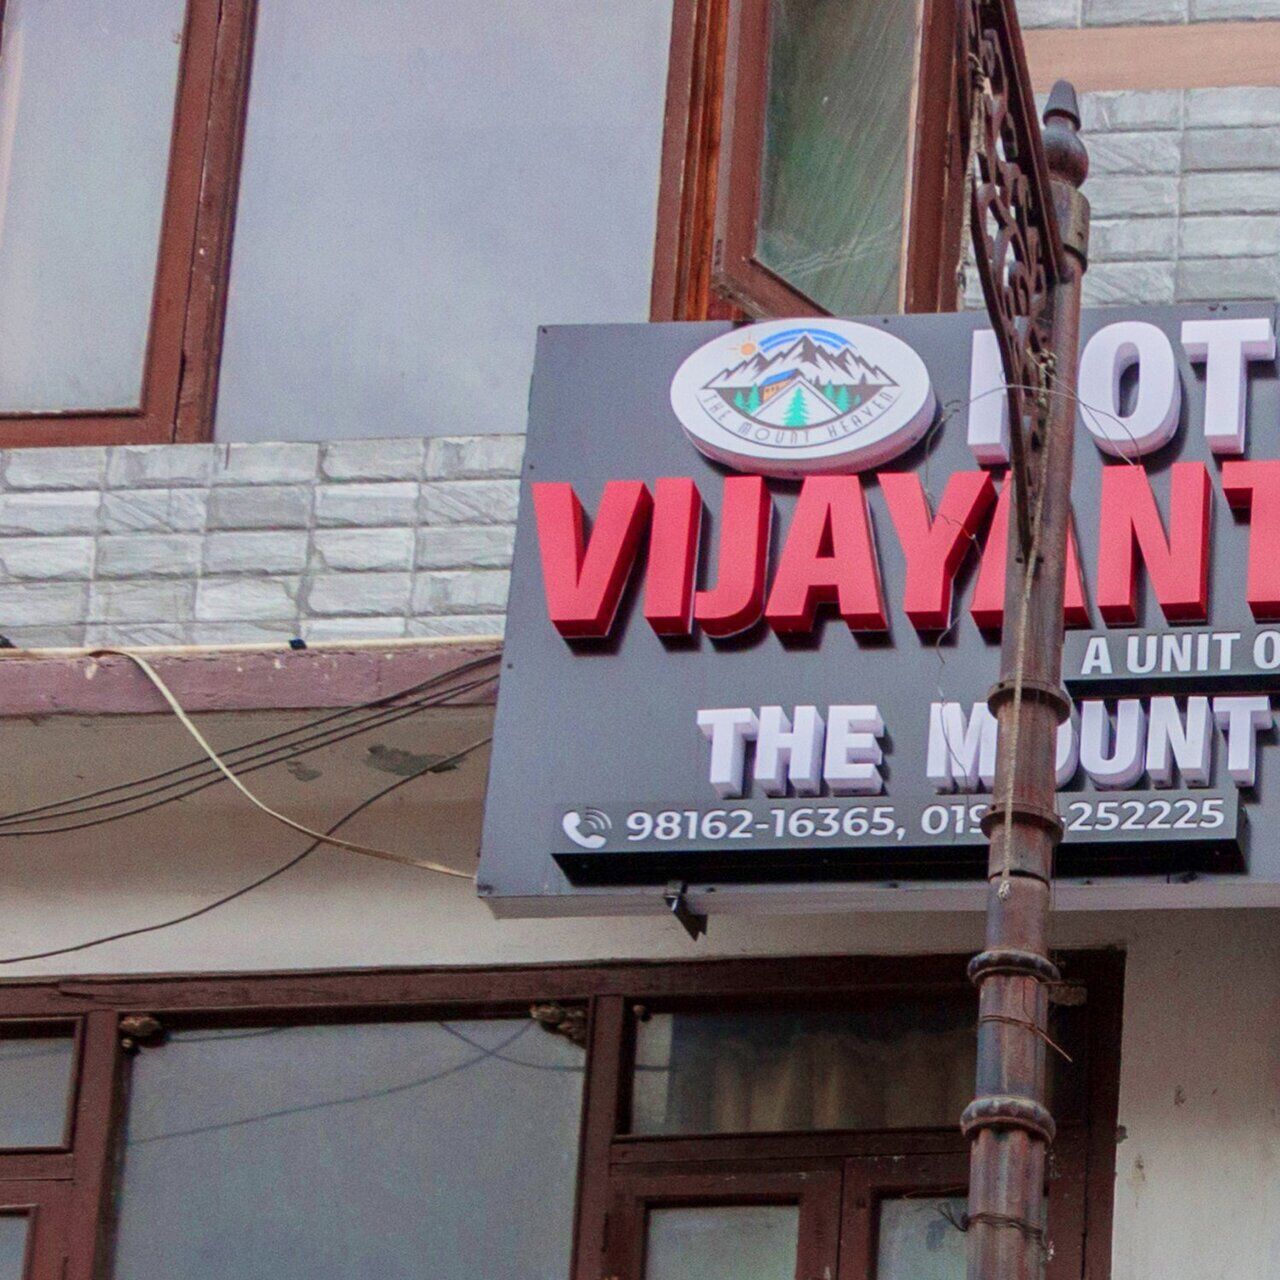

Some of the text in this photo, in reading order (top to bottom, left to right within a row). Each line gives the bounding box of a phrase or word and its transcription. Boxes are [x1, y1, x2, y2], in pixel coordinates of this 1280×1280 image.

[703, 391, 894, 445] THE MOUNT HEAVEN
[1081, 638, 1113, 675] A
[1127, 633, 1241, 674] UNIT
[697, 704, 886, 797] THE
[926, 696, 1274, 793] MUNT
[626, 806, 906, 841] 98162-16365,
